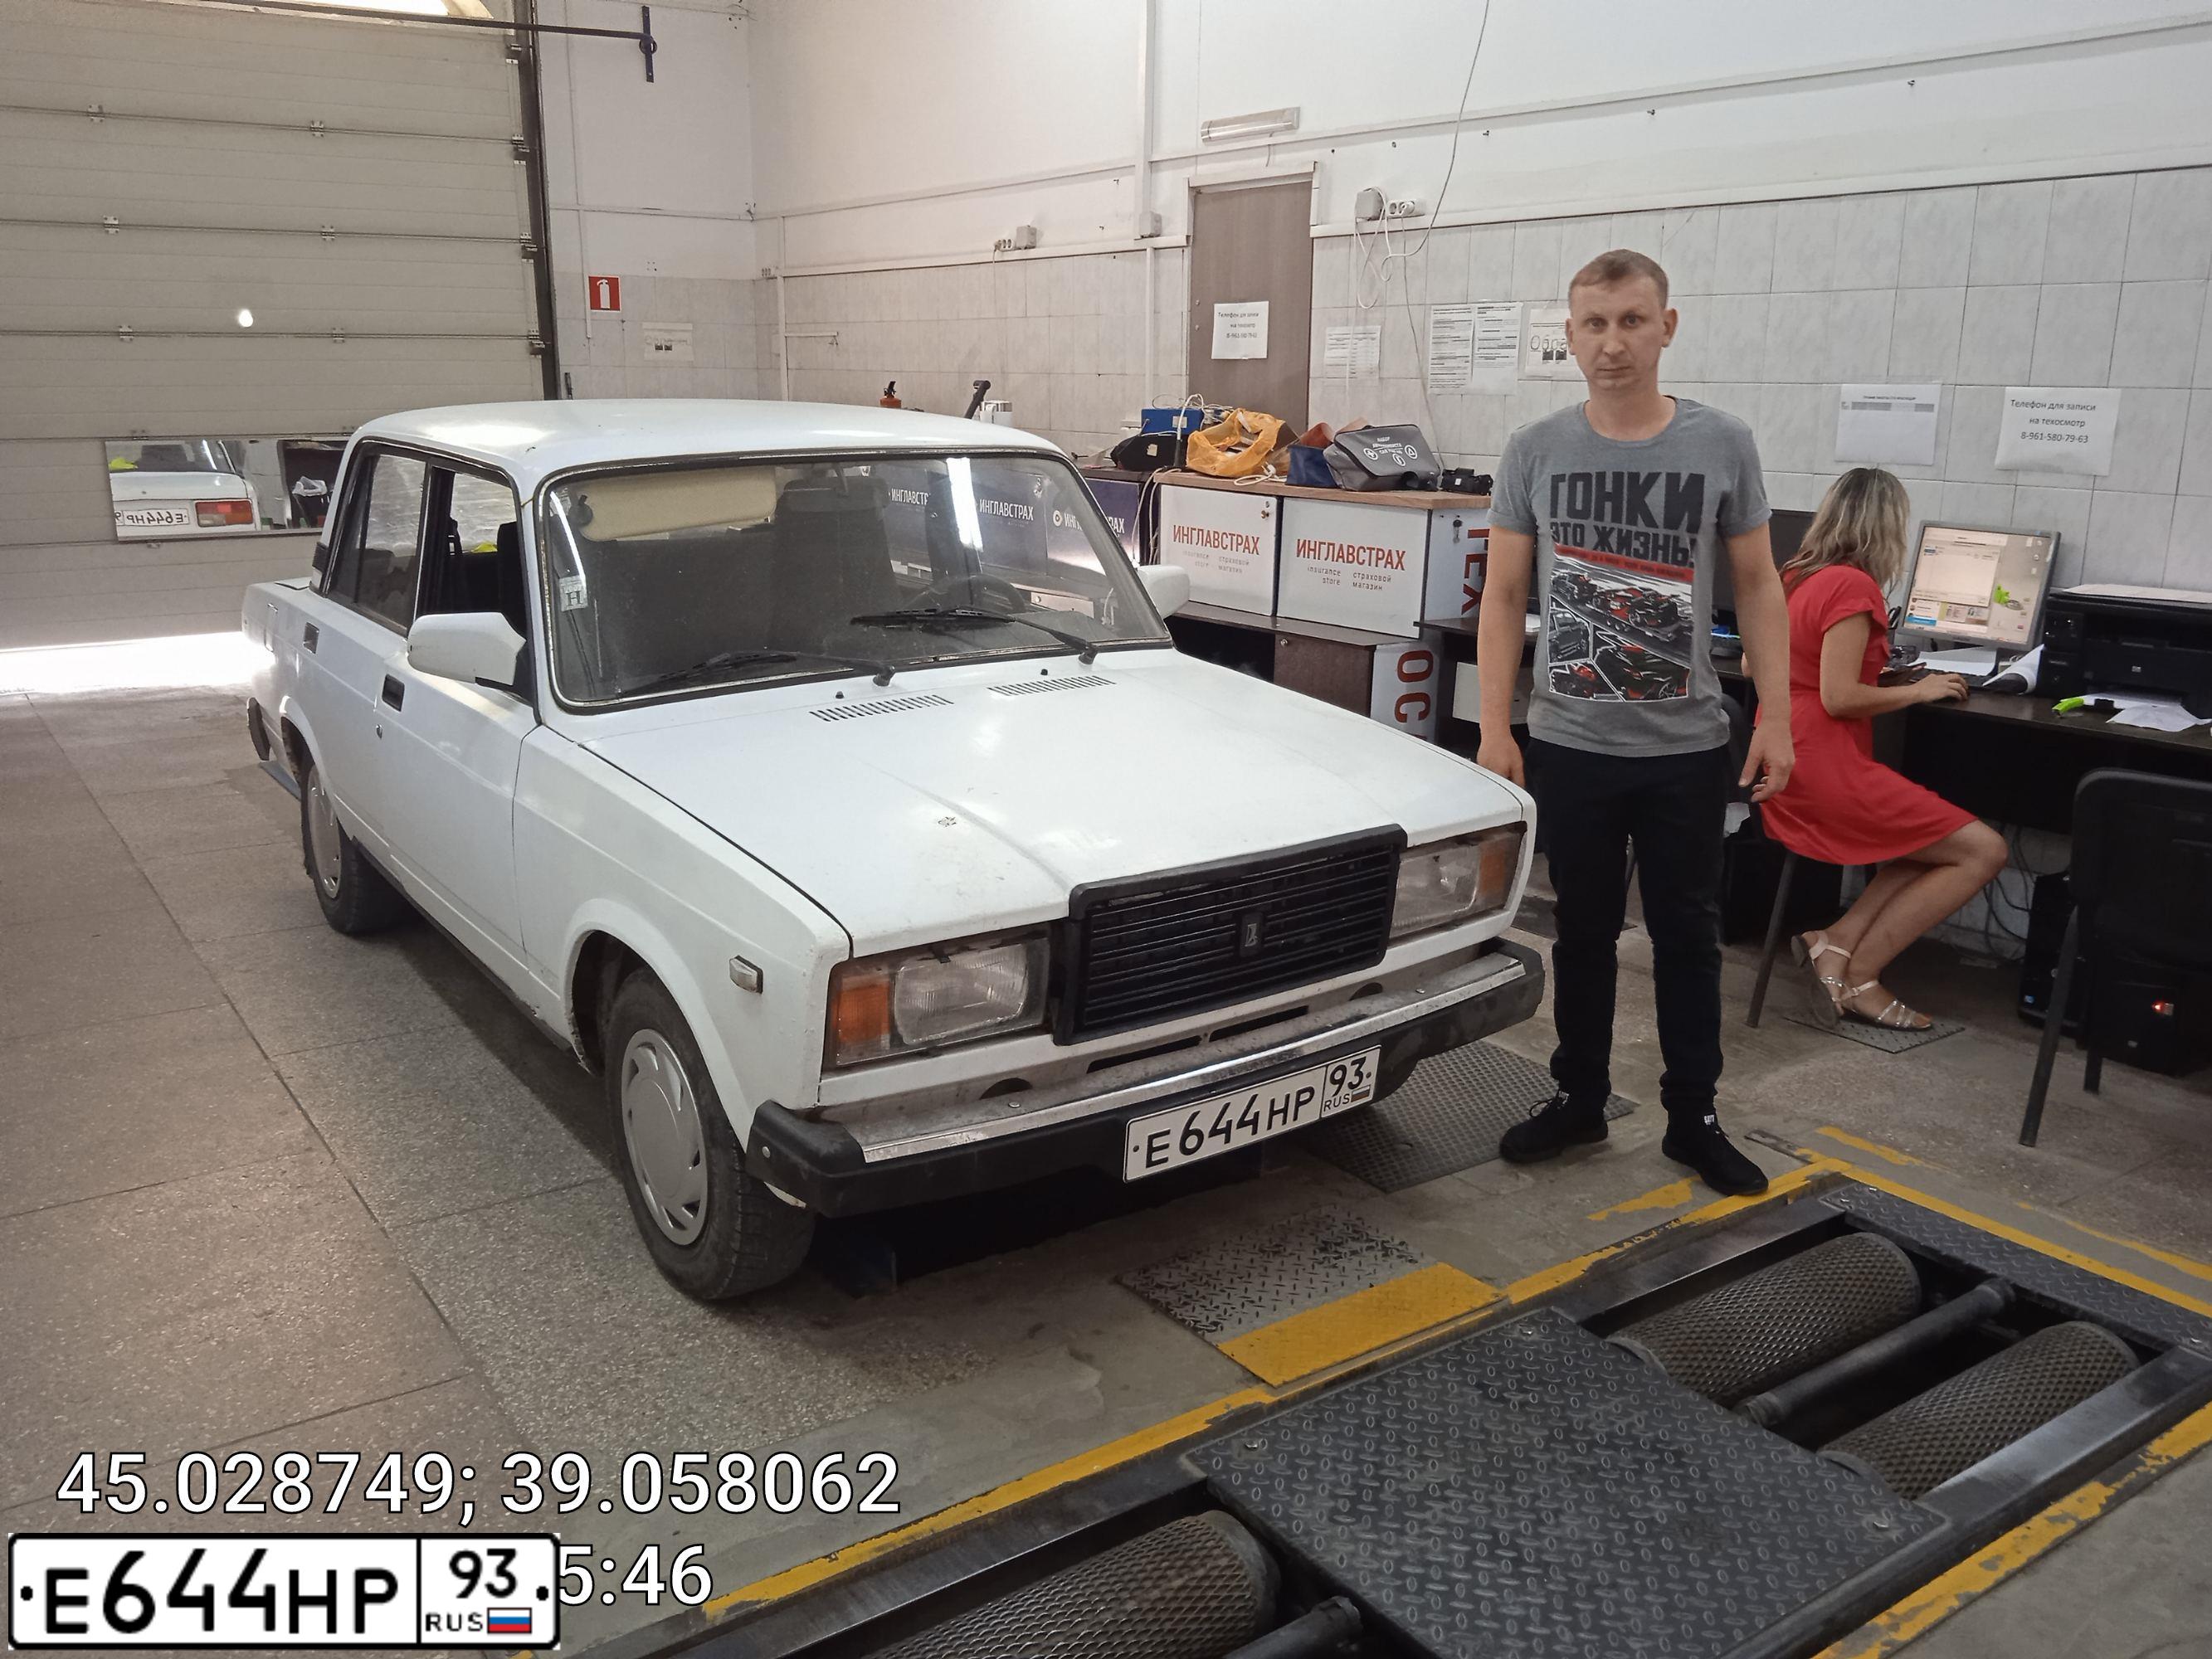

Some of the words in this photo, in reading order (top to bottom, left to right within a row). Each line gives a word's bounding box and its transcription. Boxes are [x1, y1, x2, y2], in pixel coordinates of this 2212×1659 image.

[2010, 399, 2047, 409] Телефон
[2066, 403, 2096, 411] записи
[2041, 418, 2085, 428] техосмотр
[2020, 431, 2088, 444] 8-961-580-79-63
[891, 488, 929, 506] ИНГЛАВСТР
[1550, 471, 1705, 534] ГОНКИ
[979, 499, 1034, 521] ИНГЛАВСТРАХ
[1173, 524, 1260, 556] ИНГЛАВСТРАХ
[1550, 522, 1585, 547] ЭТО
[1296, 538, 1406, 572] ИНГЛАВСТРАХ
[1308, 566, 1341, 577] insurance
[1352, 572, 1391, 583] страховой
[1322, 577, 1341, 586] store
[1352, 581, 1383, 591] магазин
[1394, 649, 1435, 738] ОС
[1323, 1092, 1350, 1112] RUS
[1146, 1086, 1315, 1169] Е644НР
[1328, 1056, 1367, 1097] 93
